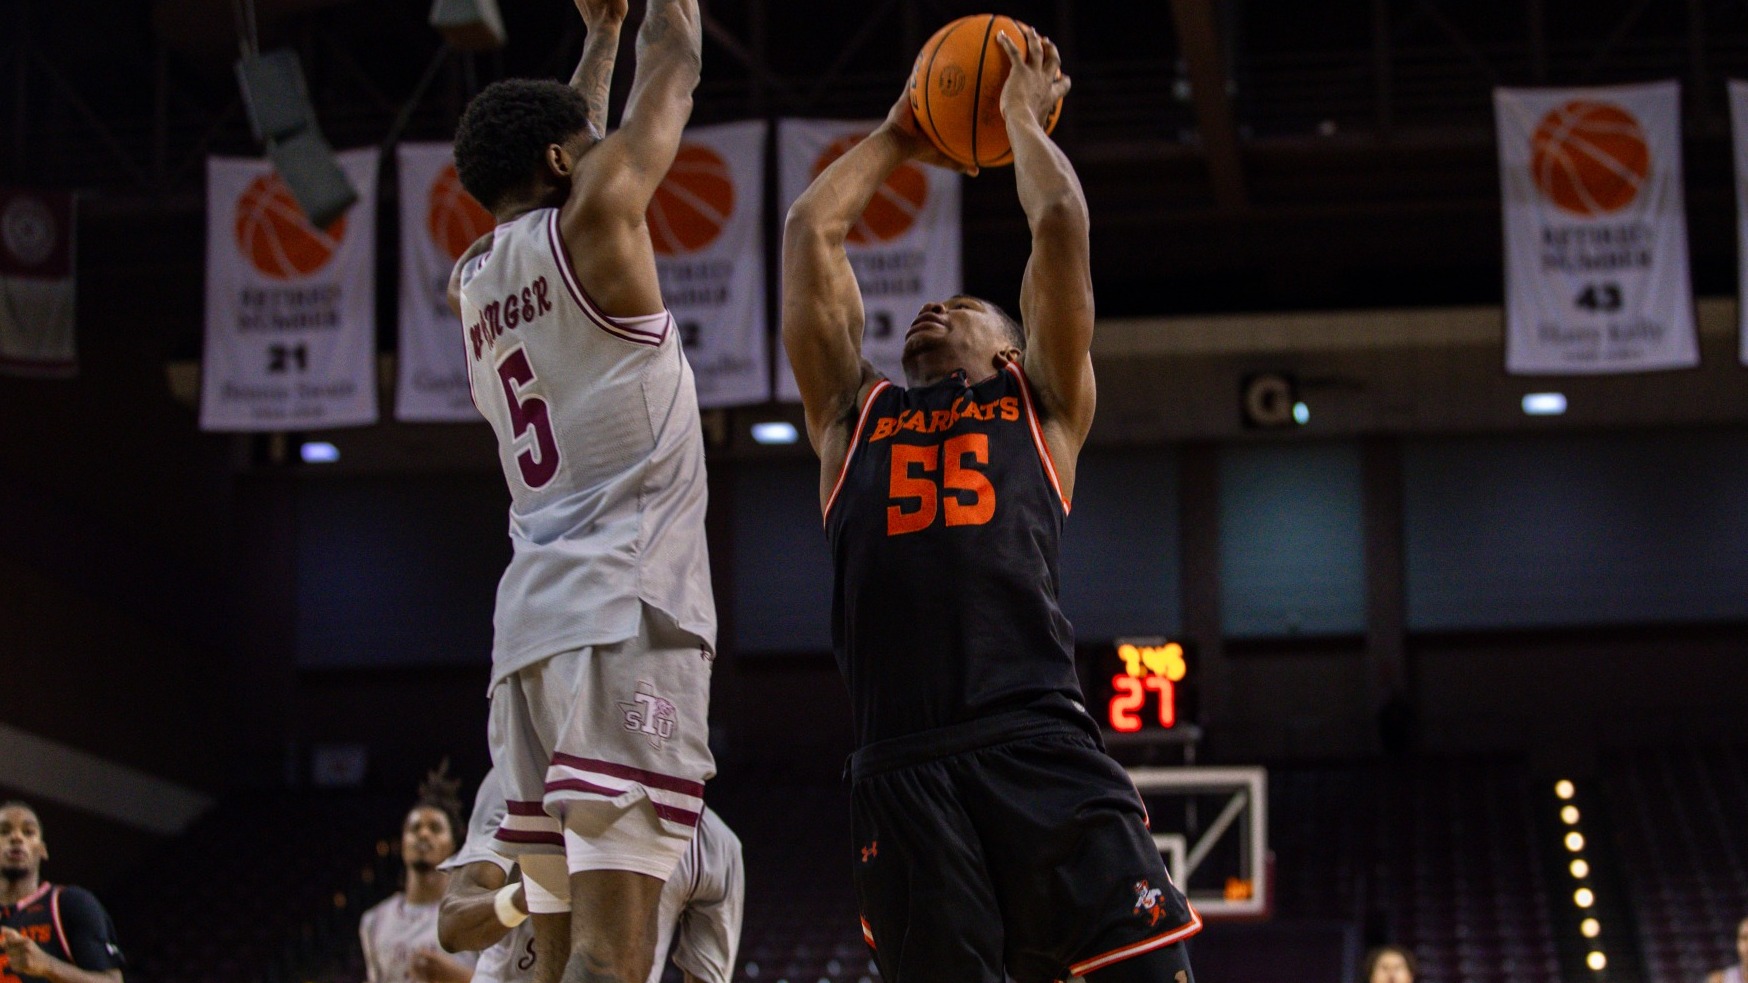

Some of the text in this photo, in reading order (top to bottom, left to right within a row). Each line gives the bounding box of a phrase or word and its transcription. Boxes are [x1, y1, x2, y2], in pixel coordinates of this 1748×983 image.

[1575, 283, 1622, 312] 43
[267, 342, 308, 373] 21
[495, 344, 561, 490] 5
[886, 432, 996, 536] 55
[1109, 674, 1175, 732] 27
